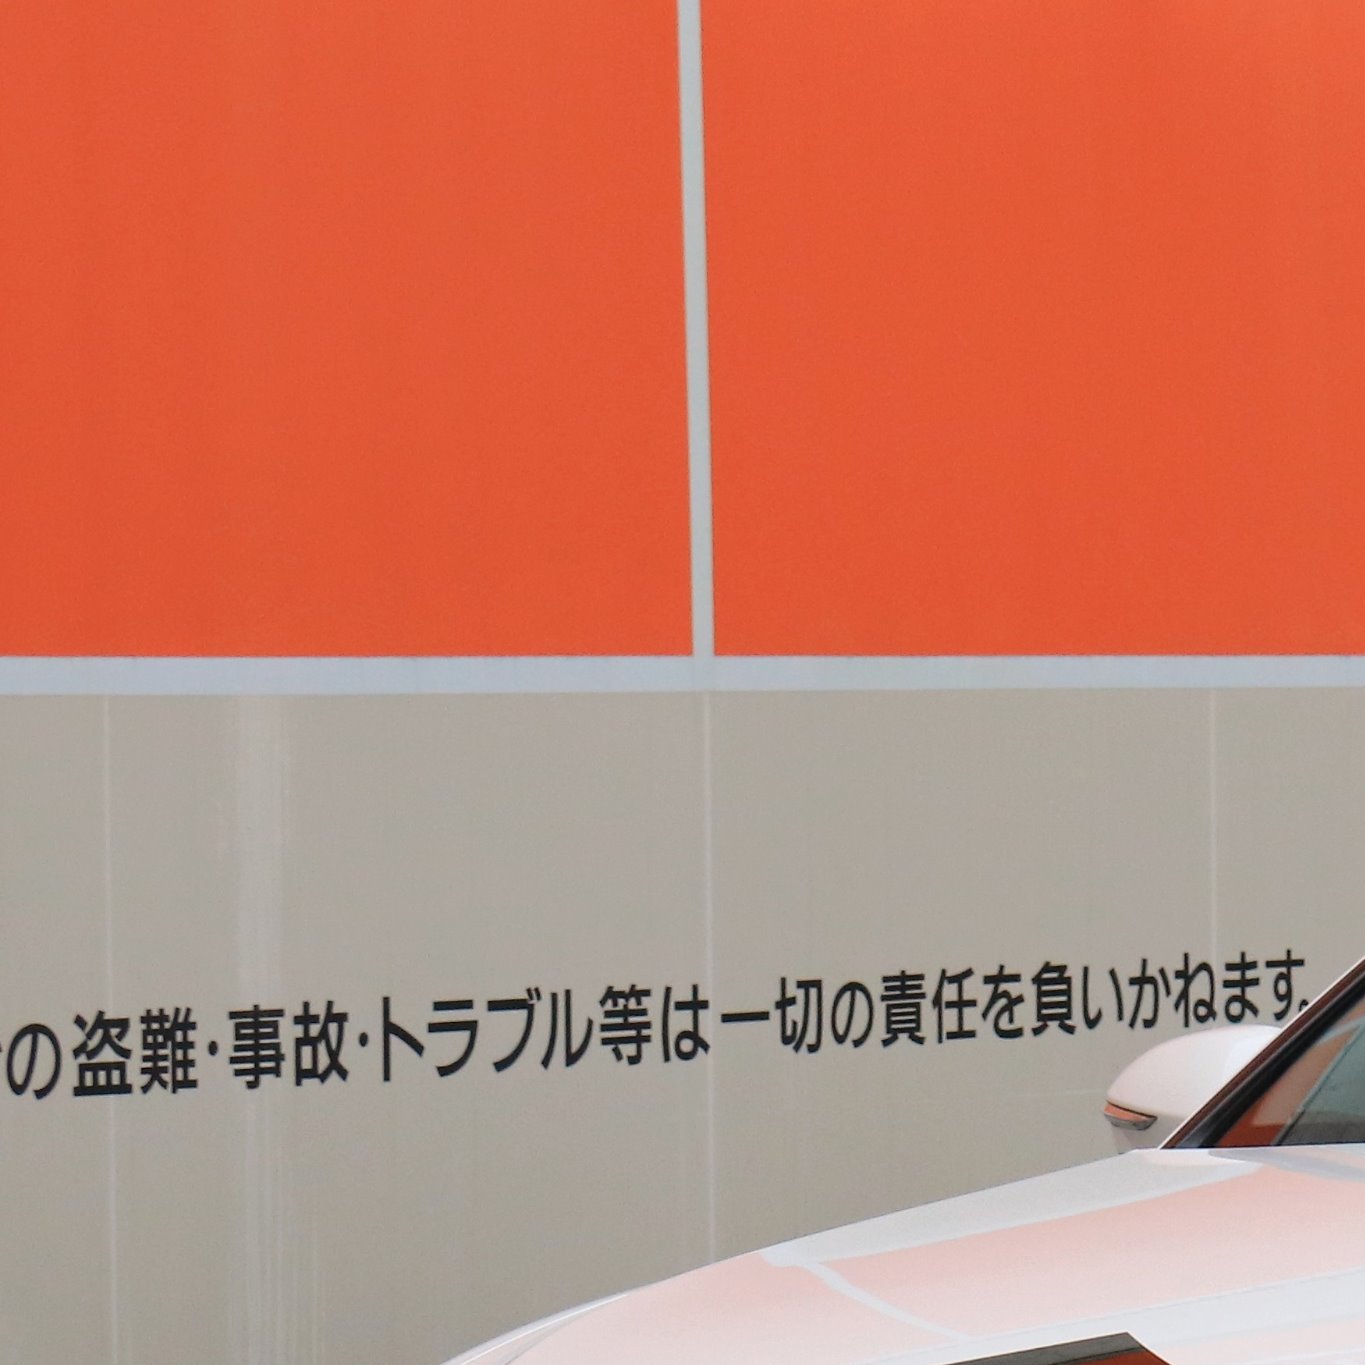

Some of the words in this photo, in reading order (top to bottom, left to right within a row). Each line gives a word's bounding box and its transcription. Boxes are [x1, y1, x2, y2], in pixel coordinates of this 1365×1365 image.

[0, 949, 1308, 1099] の盗難・事故・トラブル等は一切の責任を負いかねます。
